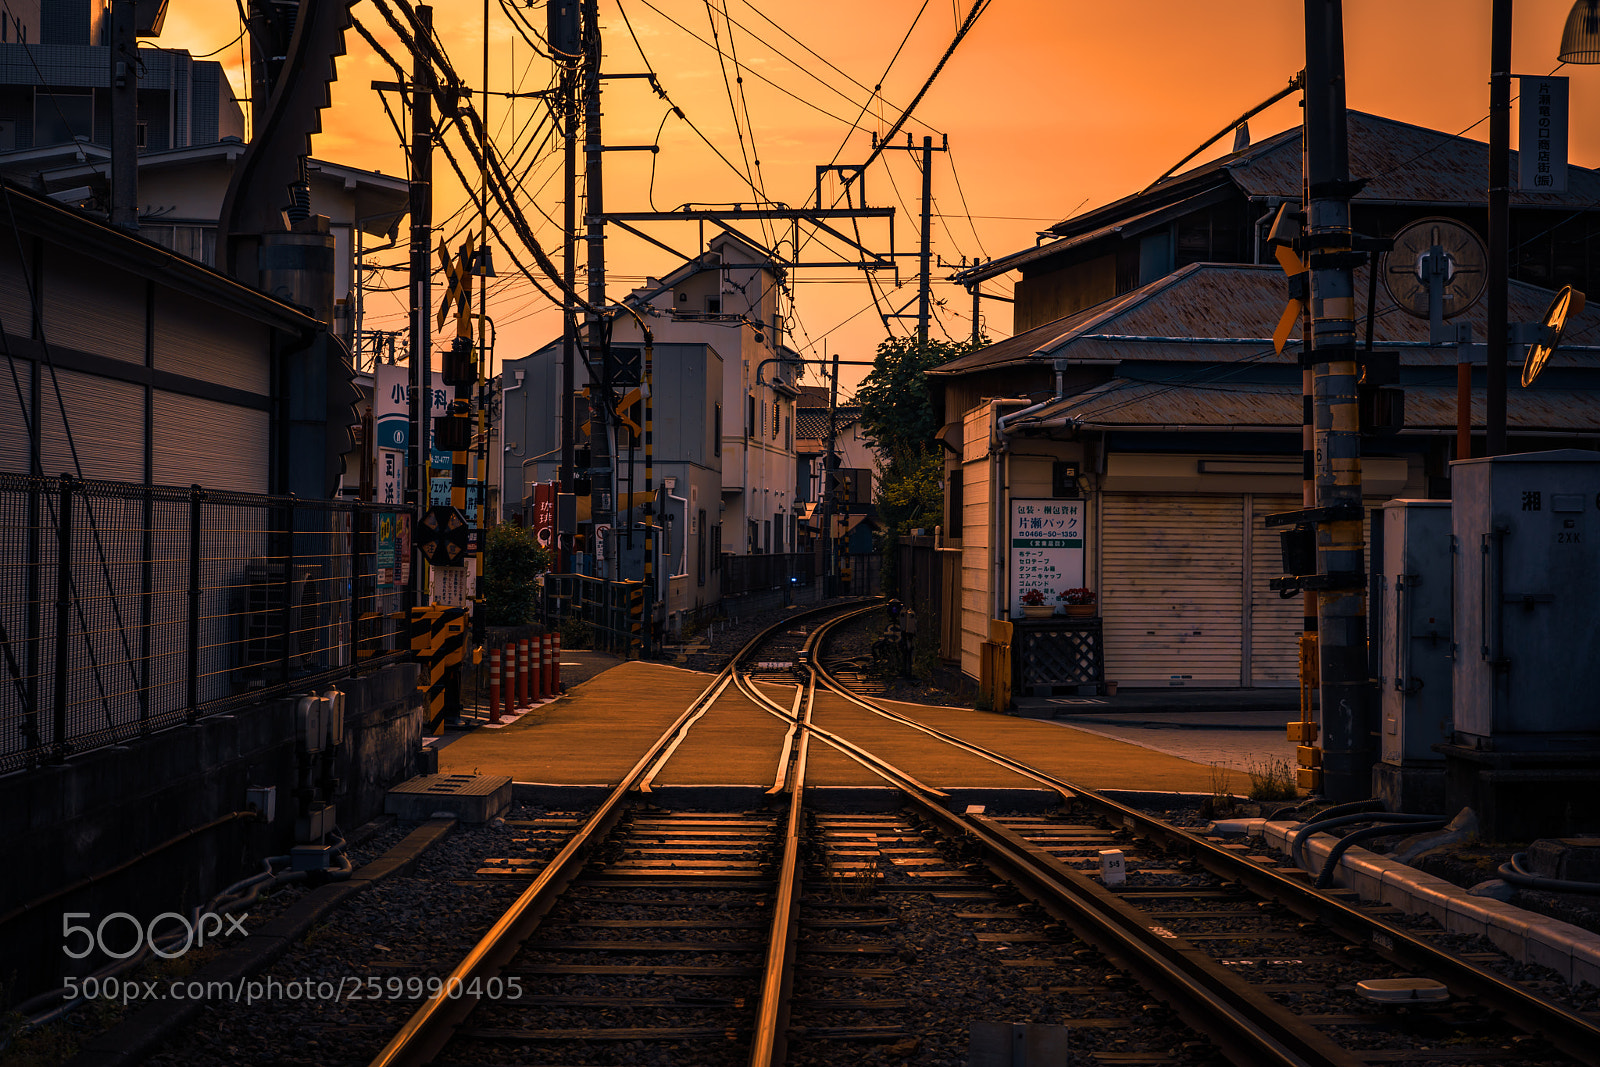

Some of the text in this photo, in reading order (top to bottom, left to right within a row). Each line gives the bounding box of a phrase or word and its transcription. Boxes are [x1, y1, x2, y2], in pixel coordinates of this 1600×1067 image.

[391, 383, 448, 410] 小科
[1522, 491, 1541, 511] 湘
[1019, 517, 1078, 529] 片瀬パック
